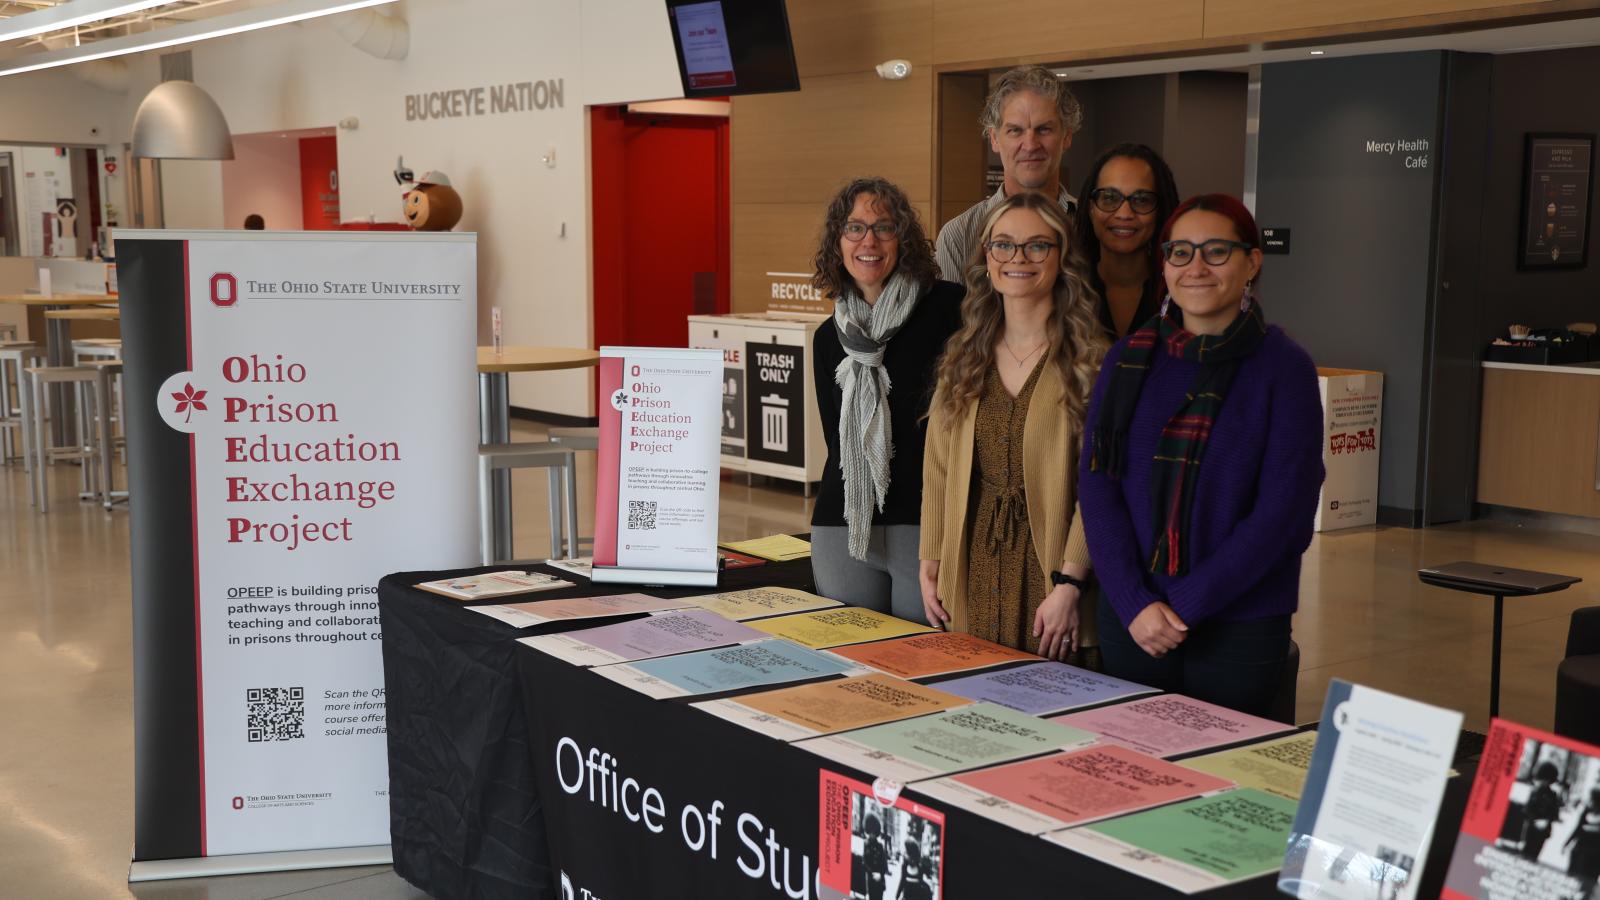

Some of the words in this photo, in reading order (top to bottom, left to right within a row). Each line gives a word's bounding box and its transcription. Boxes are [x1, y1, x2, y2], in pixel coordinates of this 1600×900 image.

[405, 87, 485, 121] BUCKEYE
[490, 78, 564, 114] NATION
[1366, 140, 1395, 155] Mercy
[1397, 139, 1429, 152] Health
[1405, 154, 1428, 169] Café
[246, 280, 277, 295] THE
[281, 280, 319, 295] OHIO
[322, 281, 368, 295] STATE
[371, 281, 461, 296] UNIVERSITY
[771, 282, 822, 301] RECYCLE
[755, 351, 795, 370] TRASH
[222, 354, 307, 384] Ohio
[760, 367, 791, 384] ONLY
[632, 382, 661, 393] Ohio
[223, 395, 339, 423] Prison
[632, 397, 672, 409] Prison
[631, 411, 692, 424] Education
[630, 426, 689, 441] Exchange
[225, 434, 401, 463] Education
[630, 441, 673, 455] Project
[225, 473, 396, 508] Exchange
[227, 514, 353, 551] Project
[227, 586, 274, 599] OPEEP
[277, 586, 287, 597] is
[291, 585, 343, 599] building
[347, 584, 379, 598] priso
[228, 603, 291, 616] pathways
[295, 600, 346, 614] through
[228, 617, 283, 630] teaching
[287, 616, 311, 628] and
[315, 615, 382, 628] collaborati
[228, 634, 240, 645] in
[244, 633, 292, 647] prisons
[295, 632, 367, 644] throughout
[324, 689, 349, 699] Scan
[352, 689, 369, 698] the
[324, 702, 350, 711] more
[353, 700, 386, 710] inform
[324, 715, 359, 724] course
[324, 727, 354, 736] social
[356, 725, 387, 736] media
[842, 785, 850, 830] OPEEP
[556, 736, 665, 834] Office
[681, 799, 725, 860] of
[736, 812, 820, 899] Stu
